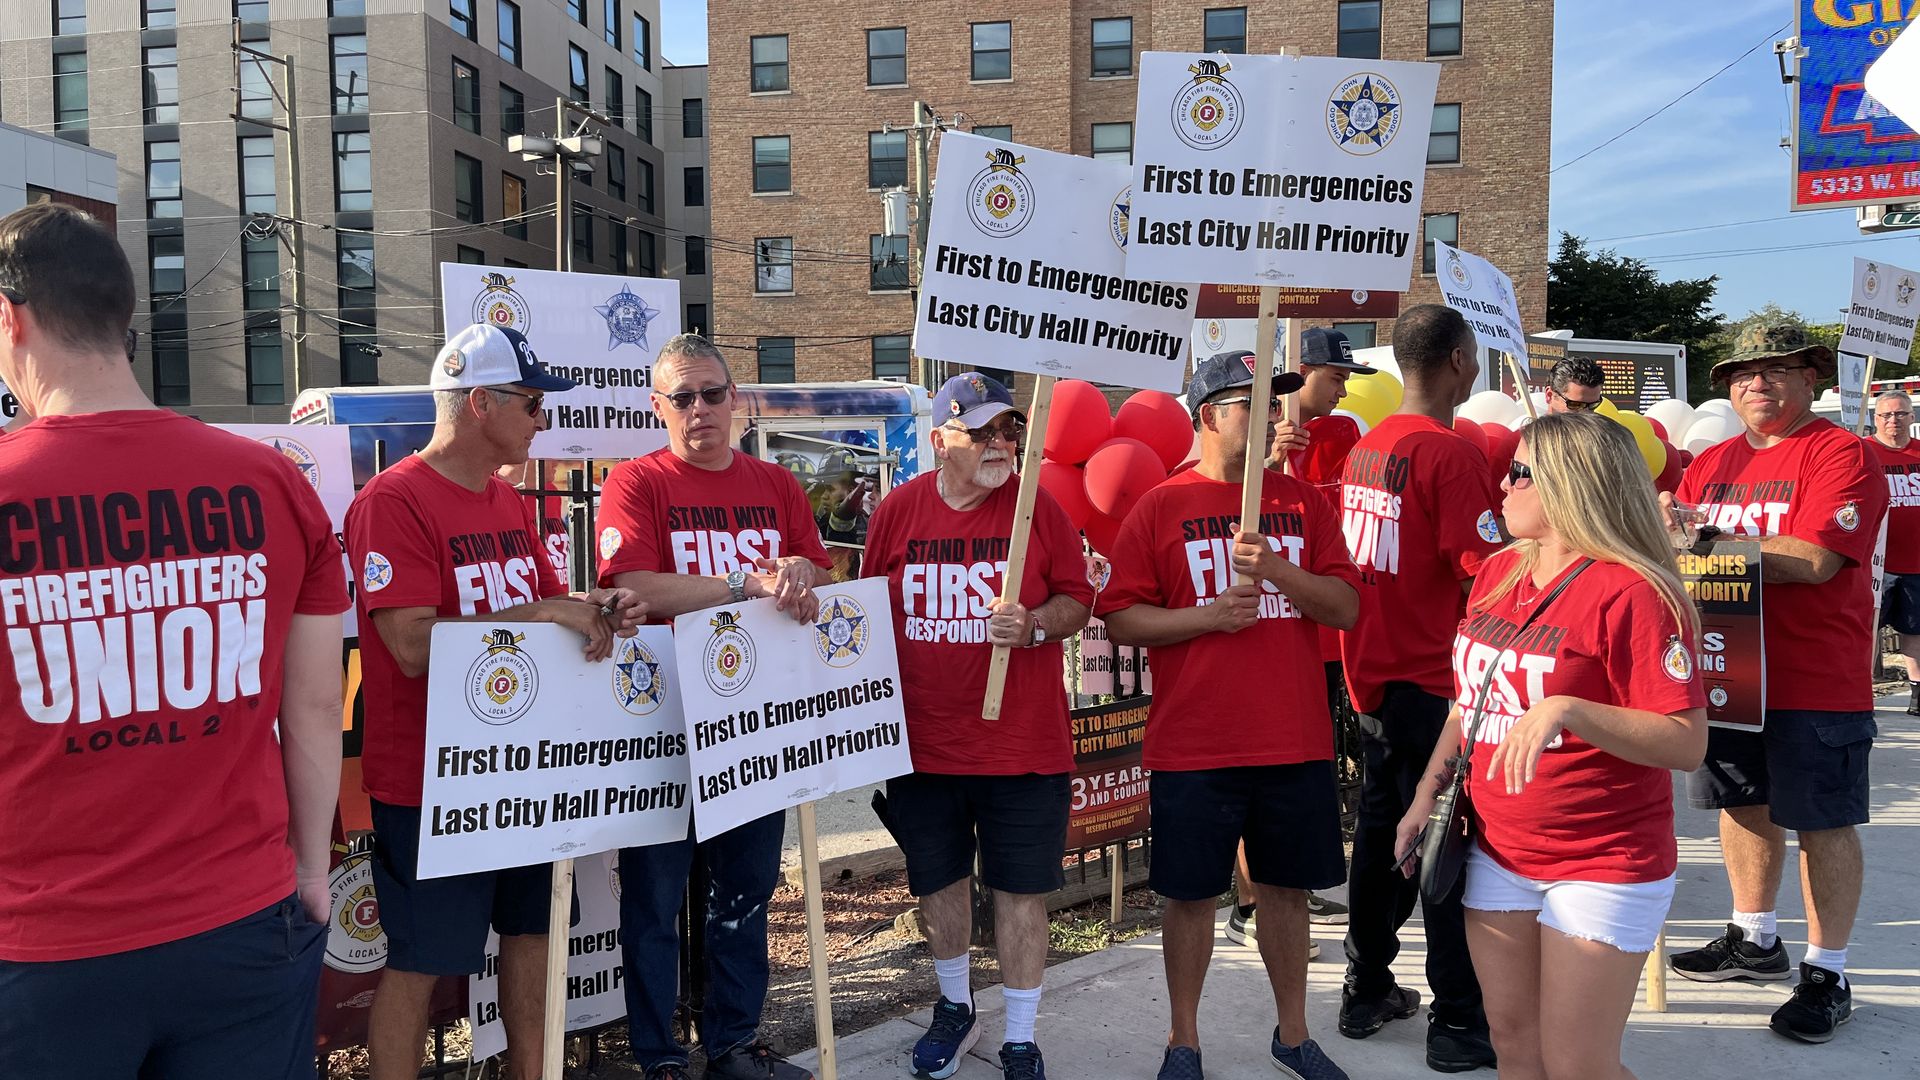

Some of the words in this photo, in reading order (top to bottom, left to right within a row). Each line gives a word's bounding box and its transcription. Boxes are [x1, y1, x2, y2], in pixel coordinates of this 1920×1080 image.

[1341, 78, 1358, 93] JOHN
[1376, 79, 1396, 100] DINEEN
[1181, 95, 1191, 121] CHICAGO
[1191, 87, 1203, 96] FIRE
[1206, 86, 1230, 104] FIGHTERS
[1194, 133, 1213, 141] LOCAL
[1330, 107, 1342, 139] CHICAGO
[1388, 110, 1398, 134] LODGE
[975, 182, 987, 207] CHICAGO
[986, 175, 999, 183] FIRE
[1000, 174, 1023, 193] FIGHTERS
[1143, 164, 1203, 195] First
[1208, 168, 1235, 195] to
[1241, 168, 1413, 204] Emergencies
[1811, 175, 1863, 195] 5333
[986, 219, 1004, 229] LOCAL
[1113, 210, 1123, 241] CHICAGO
[1137, 216, 1192, 246] Last
[1198, 219, 1251, 251] City
[1256, 221, 1310, 250] Hall
[1315, 223, 1410, 258] Priority
[936, 244, 992, 281] First
[998, 256, 1022, 284] to
[1027, 260, 1189, 310] Emergencies
[1279, 295, 1320, 305] CONTRACT
[1446, 292, 1470, 309] First
[1470, 298, 1481, 312] to
[928, 295, 979, 329] Last
[983, 304, 1034, 340] City
[1038, 312, 1089, 345] Hall
[1092, 320, 1183, 361] Priority
[1476, 320, 1496, 338] City
[1851, 302, 1868, 317] First
[1868, 307, 1875, 319] to
[1875, 309, 1914, 328] Emergencies
[1846, 324, 1861, 340] Last
[1862, 328, 1875, 342] City
[1875, 330, 1887, 344] Hall
[1887, 333, 1911, 350] Priority
[539, 362, 651, 389] mergenci
[558, 405, 598, 429] Hall
[286, 441, 310, 460] DINEEN
[1346, 448, 1409, 494] HICAGO
[1700, 483, 1749, 504] STAND
[1751, 480, 1796, 502] WITH
[0, 485, 266, 574] CHICAGO
[668, 506, 729, 530] STAND
[732, 505, 777, 529] WITH
[449, 532, 496, 565] STAND
[670, 529, 782, 577] FIRST
[906, 539, 965, 563] STAND
[0, 553, 267, 625] FIREFIGHTERS
[1683, 581, 1752, 602] RIORITY
[843, 598, 861, 613] DINEEN
[7, 599, 266, 724] UNION
[1083, 654, 1097, 672] Last
[1098, 654, 1113, 673] City
[475, 668, 486, 696] CHICAGO
[485, 658, 498, 669] FIRE
[500, 656, 525, 672] FIGHTERS
[616, 671, 626, 701] CHICAGO
[694, 714, 737, 751] First
[739, 710, 759, 735] to
[763, 677, 894, 729] Emergencies
[1088, 715, 1101, 733] TO
[1103, 705, 1151, 730] EMERGENC
[65, 723, 186, 754] LOCAL
[202, 715, 221, 737] 2
[1080, 735, 1104, 754] CITY
[1106, 731, 1127, 749] HALL
[437, 744, 499, 778] First
[504, 744, 531, 772] to
[537, 731, 687, 769] Emergencies
[698, 765, 737, 803] Last
[739, 754, 778, 786] City
[782, 738, 823, 773] Hall
[825, 721, 900, 761] Priority
[1071, 777, 1088, 811] 3
[1090, 790, 1110, 807] AND
[1113, 779, 1150, 800] COUNTIN
[431, 803, 489, 837] Last
[495, 797, 547, 830] City
[551, 789, 599, 823] Hall
[604, 781, 687, 816] Priority
[1071, 815, 1096, 828] CHICAGO
[1085, 820, 1108, 834] DESERVE
[1112, 815, 1135, 829] CONTRACT
[338, 873, 358, 891] FIRE
[362, 905, 375, 921] F
[348, 947, 379, 958] LOCAL
[382, 942, 388, 950] 2
[567, 969, 608, 1000] Hall
